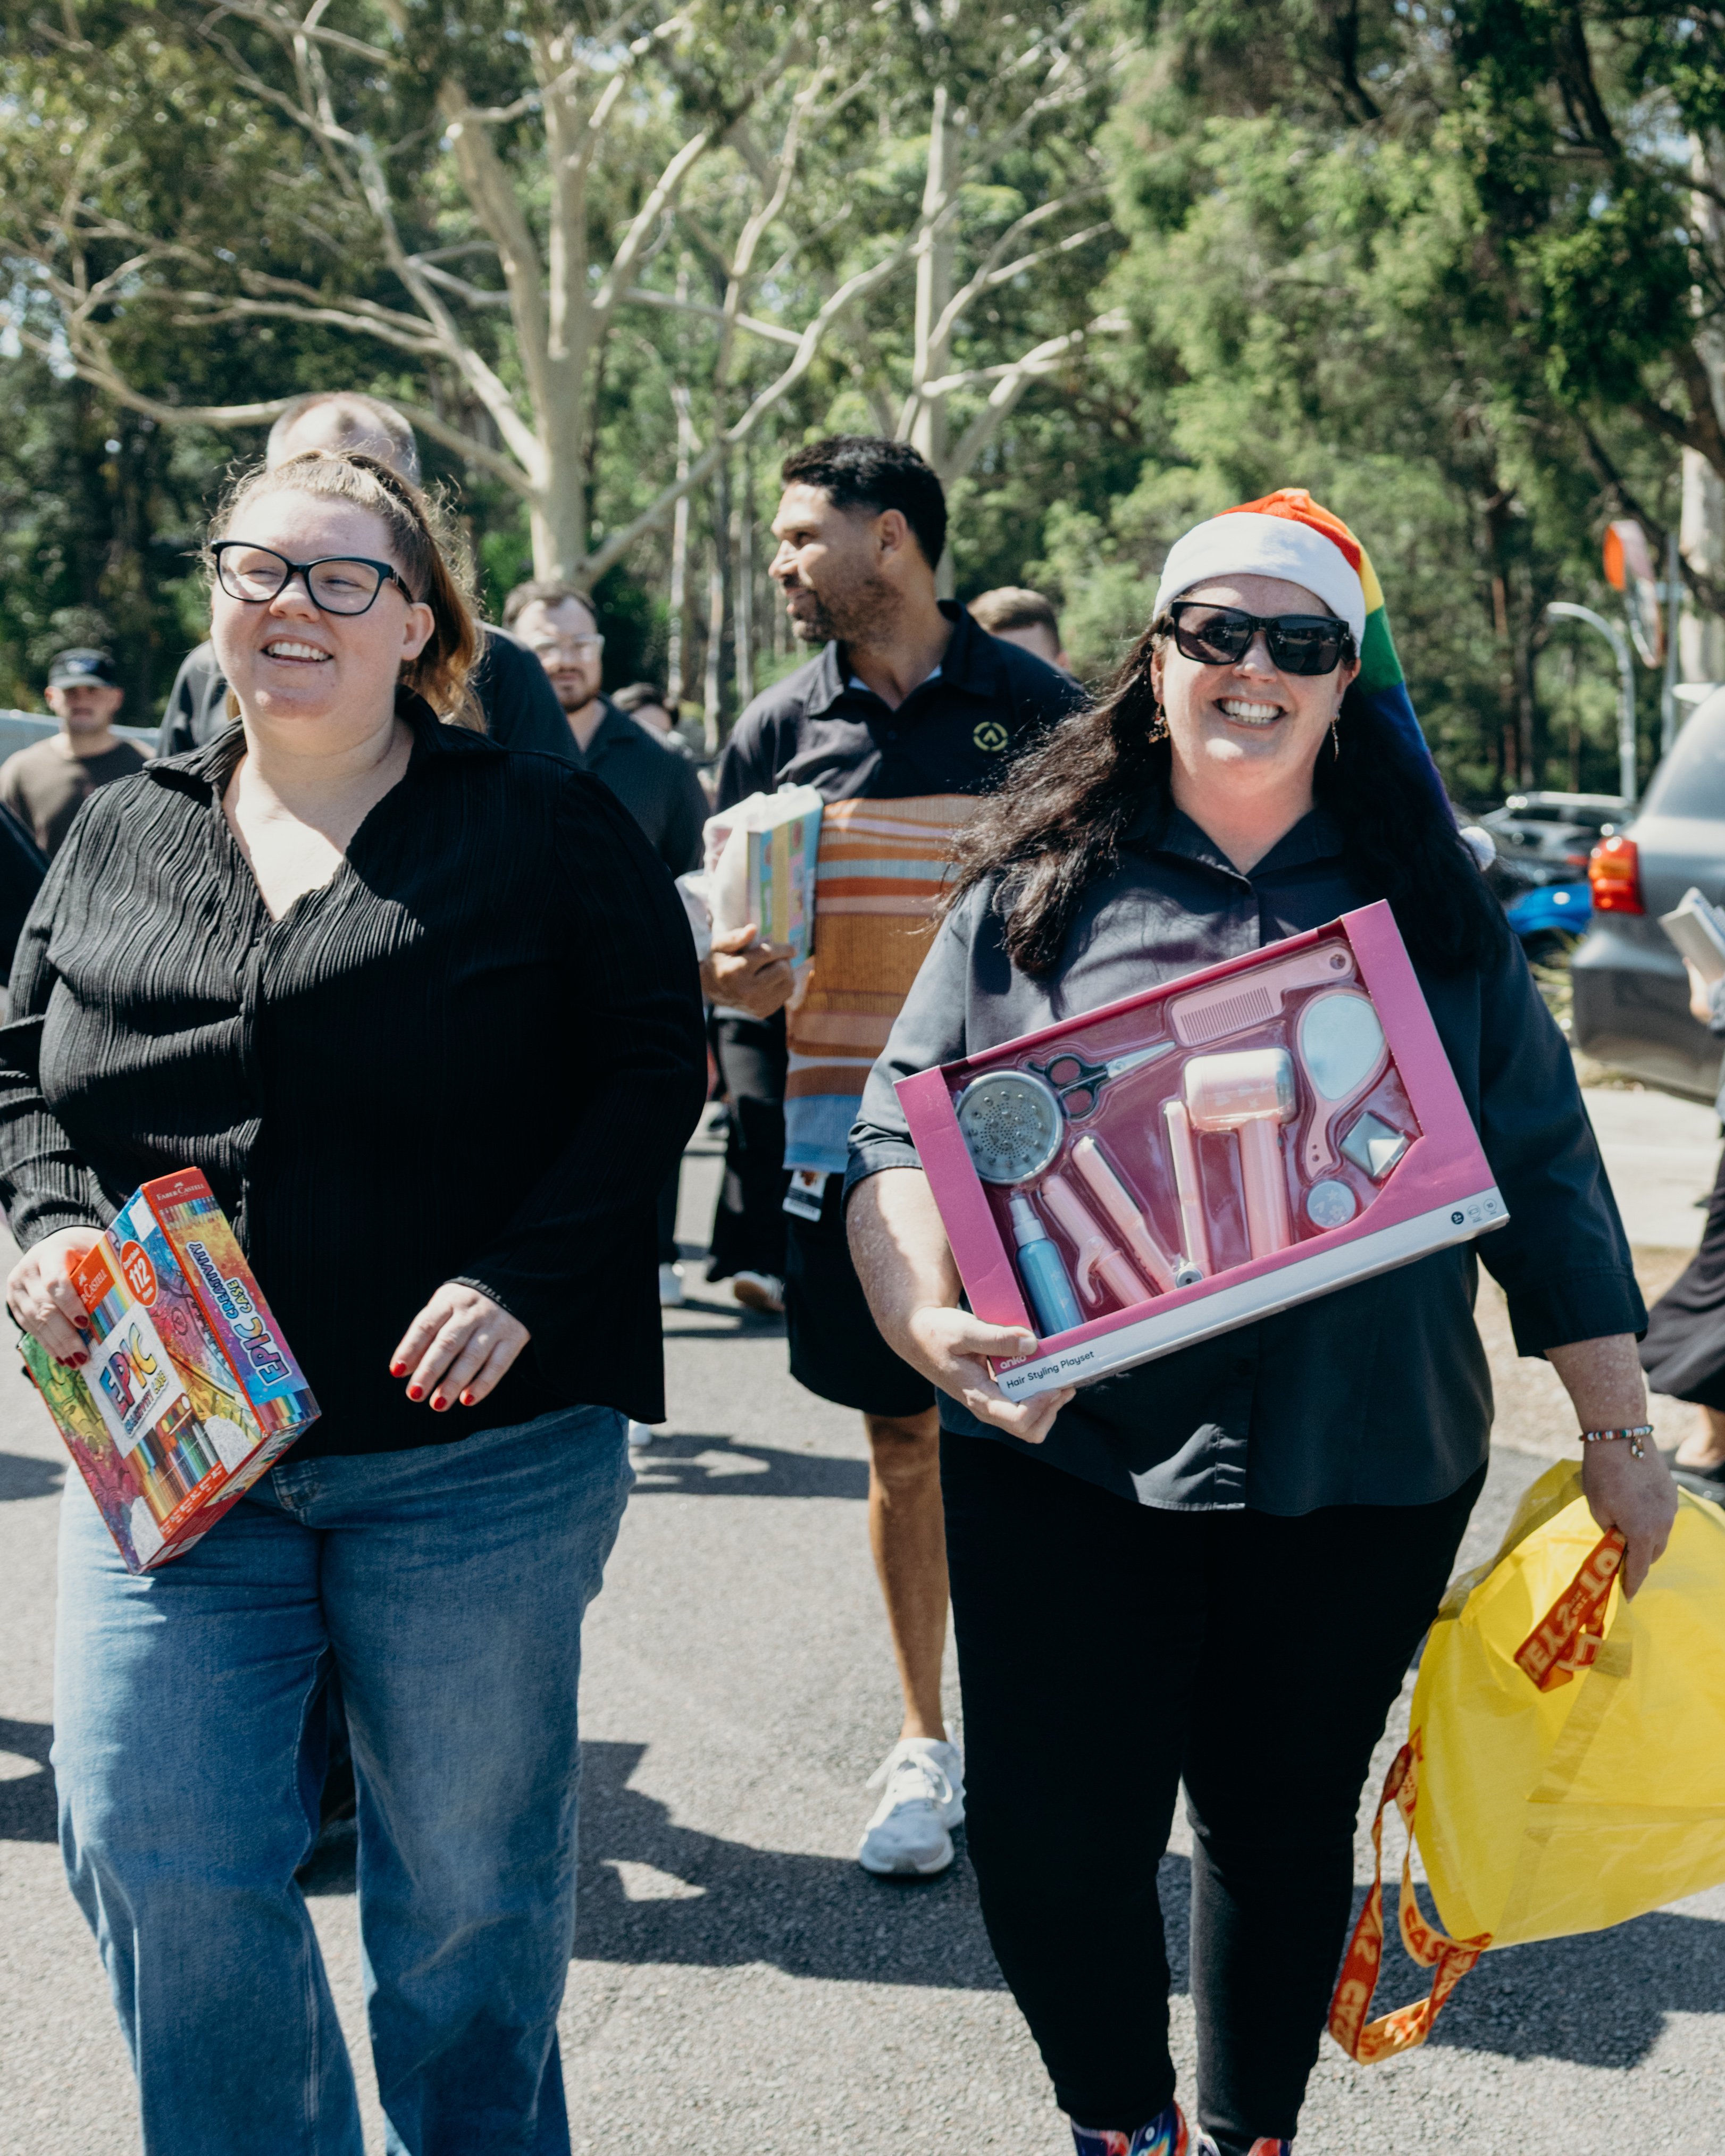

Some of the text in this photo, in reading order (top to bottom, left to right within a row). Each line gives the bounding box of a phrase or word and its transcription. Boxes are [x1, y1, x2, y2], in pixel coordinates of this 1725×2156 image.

[129, 1258, 150, 1293] 112
[189, 1243, 239, 1319] CREATIVITY
[227, 1279, 253, 1313] CASE
[234, 1316, 290, 1384] EPIC
[1000, 1355, 1027, 1370] anko
[1006, 1350, 1095, 1389] Hair Styling Playset
[99, 1322, 157, 1421] EPIC
